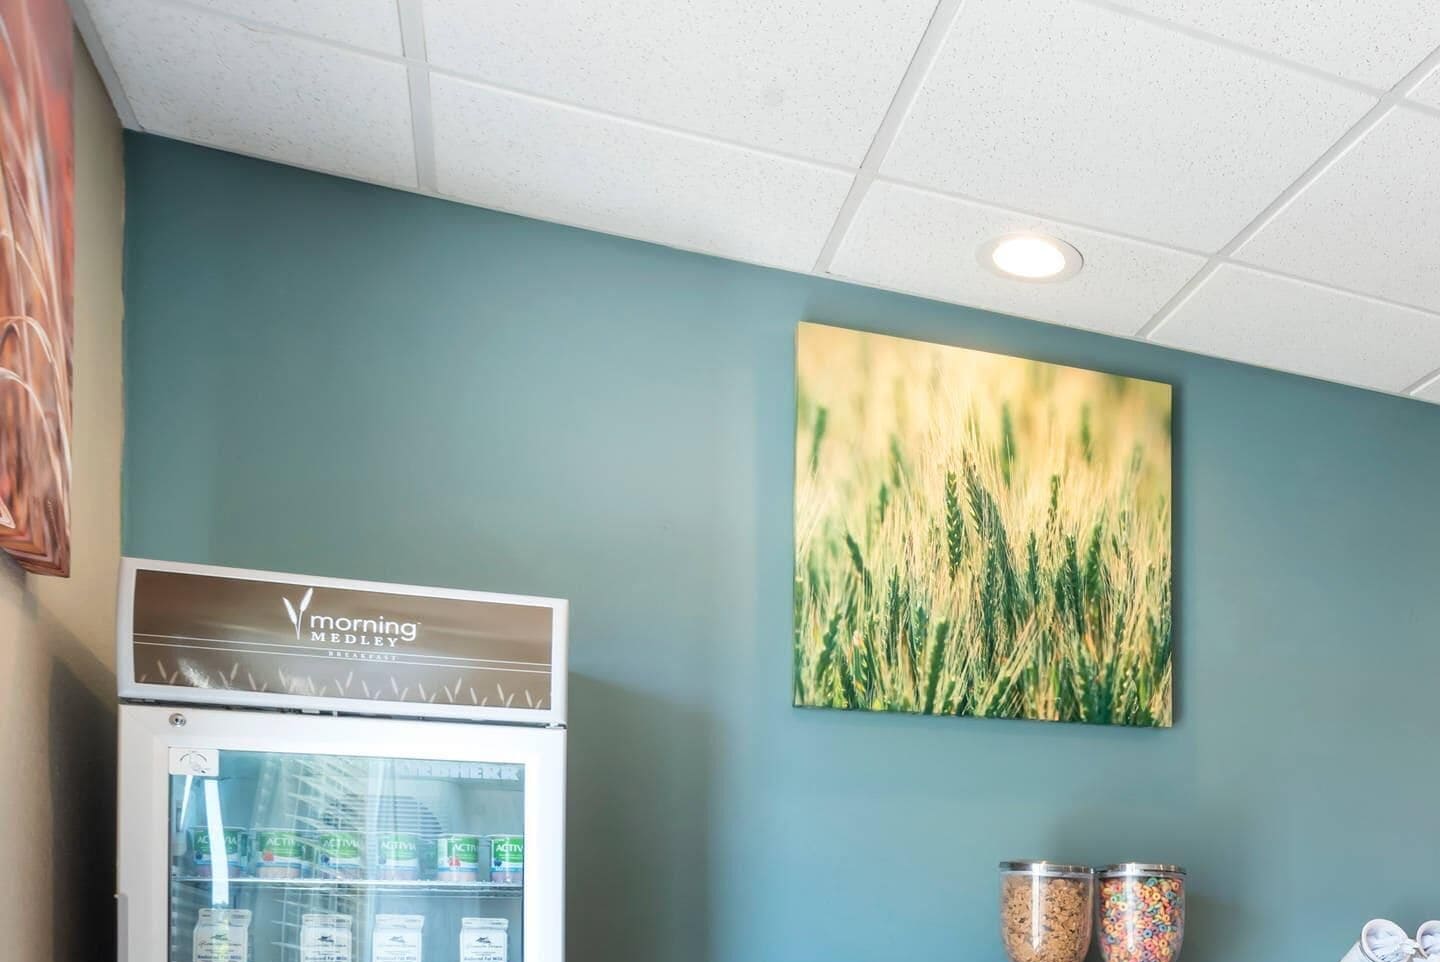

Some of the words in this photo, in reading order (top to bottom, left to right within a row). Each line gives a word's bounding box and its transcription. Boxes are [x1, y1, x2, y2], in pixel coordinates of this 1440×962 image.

[310, 615, 417, 641] morning
[310, 631, 398, 647] MEDLEY
[328, 651, 398, 661] BREAKFAST
